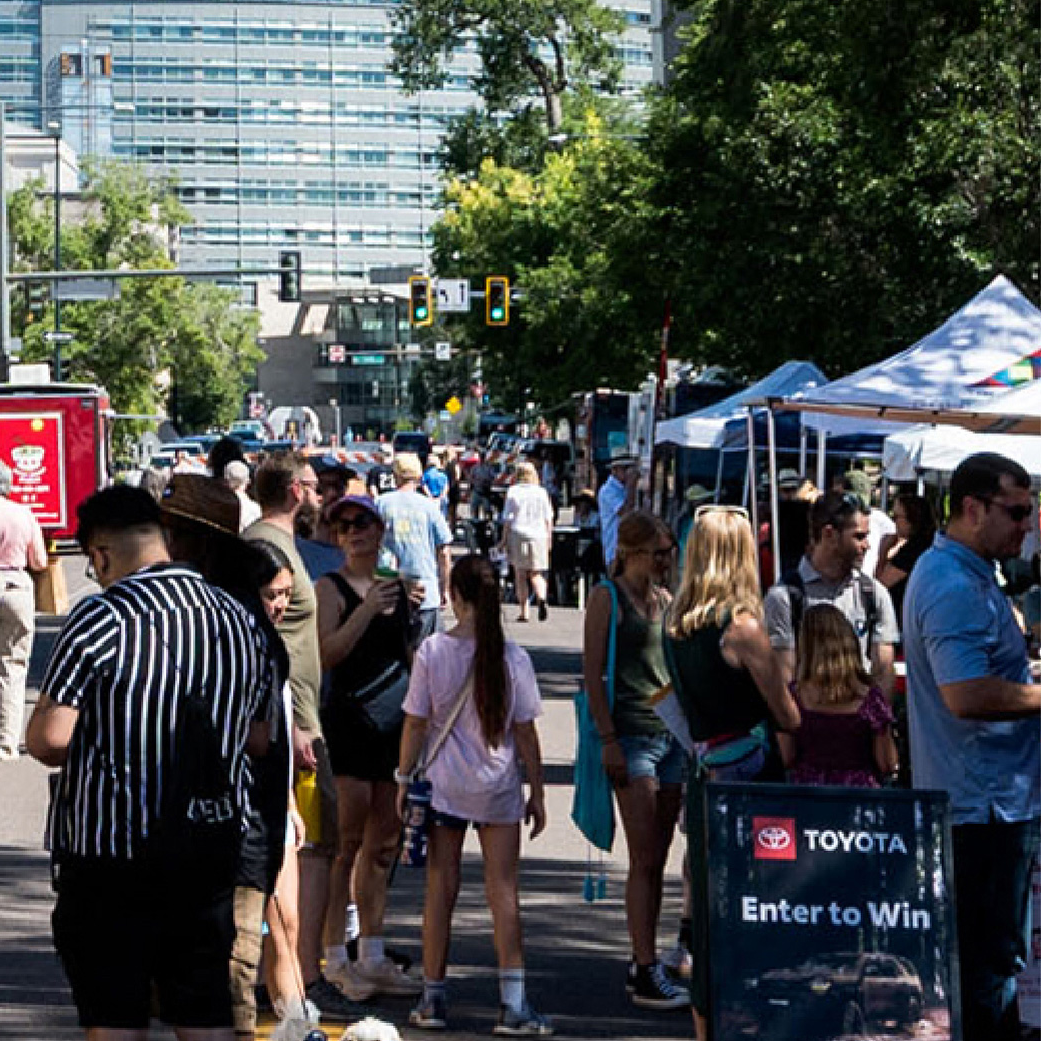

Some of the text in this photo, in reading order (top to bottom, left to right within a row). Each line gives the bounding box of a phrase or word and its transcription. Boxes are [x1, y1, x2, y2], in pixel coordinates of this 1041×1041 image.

[803, 829, 908, 854] TOYOTA
[741, 896, 931, 930] Enter to Win
